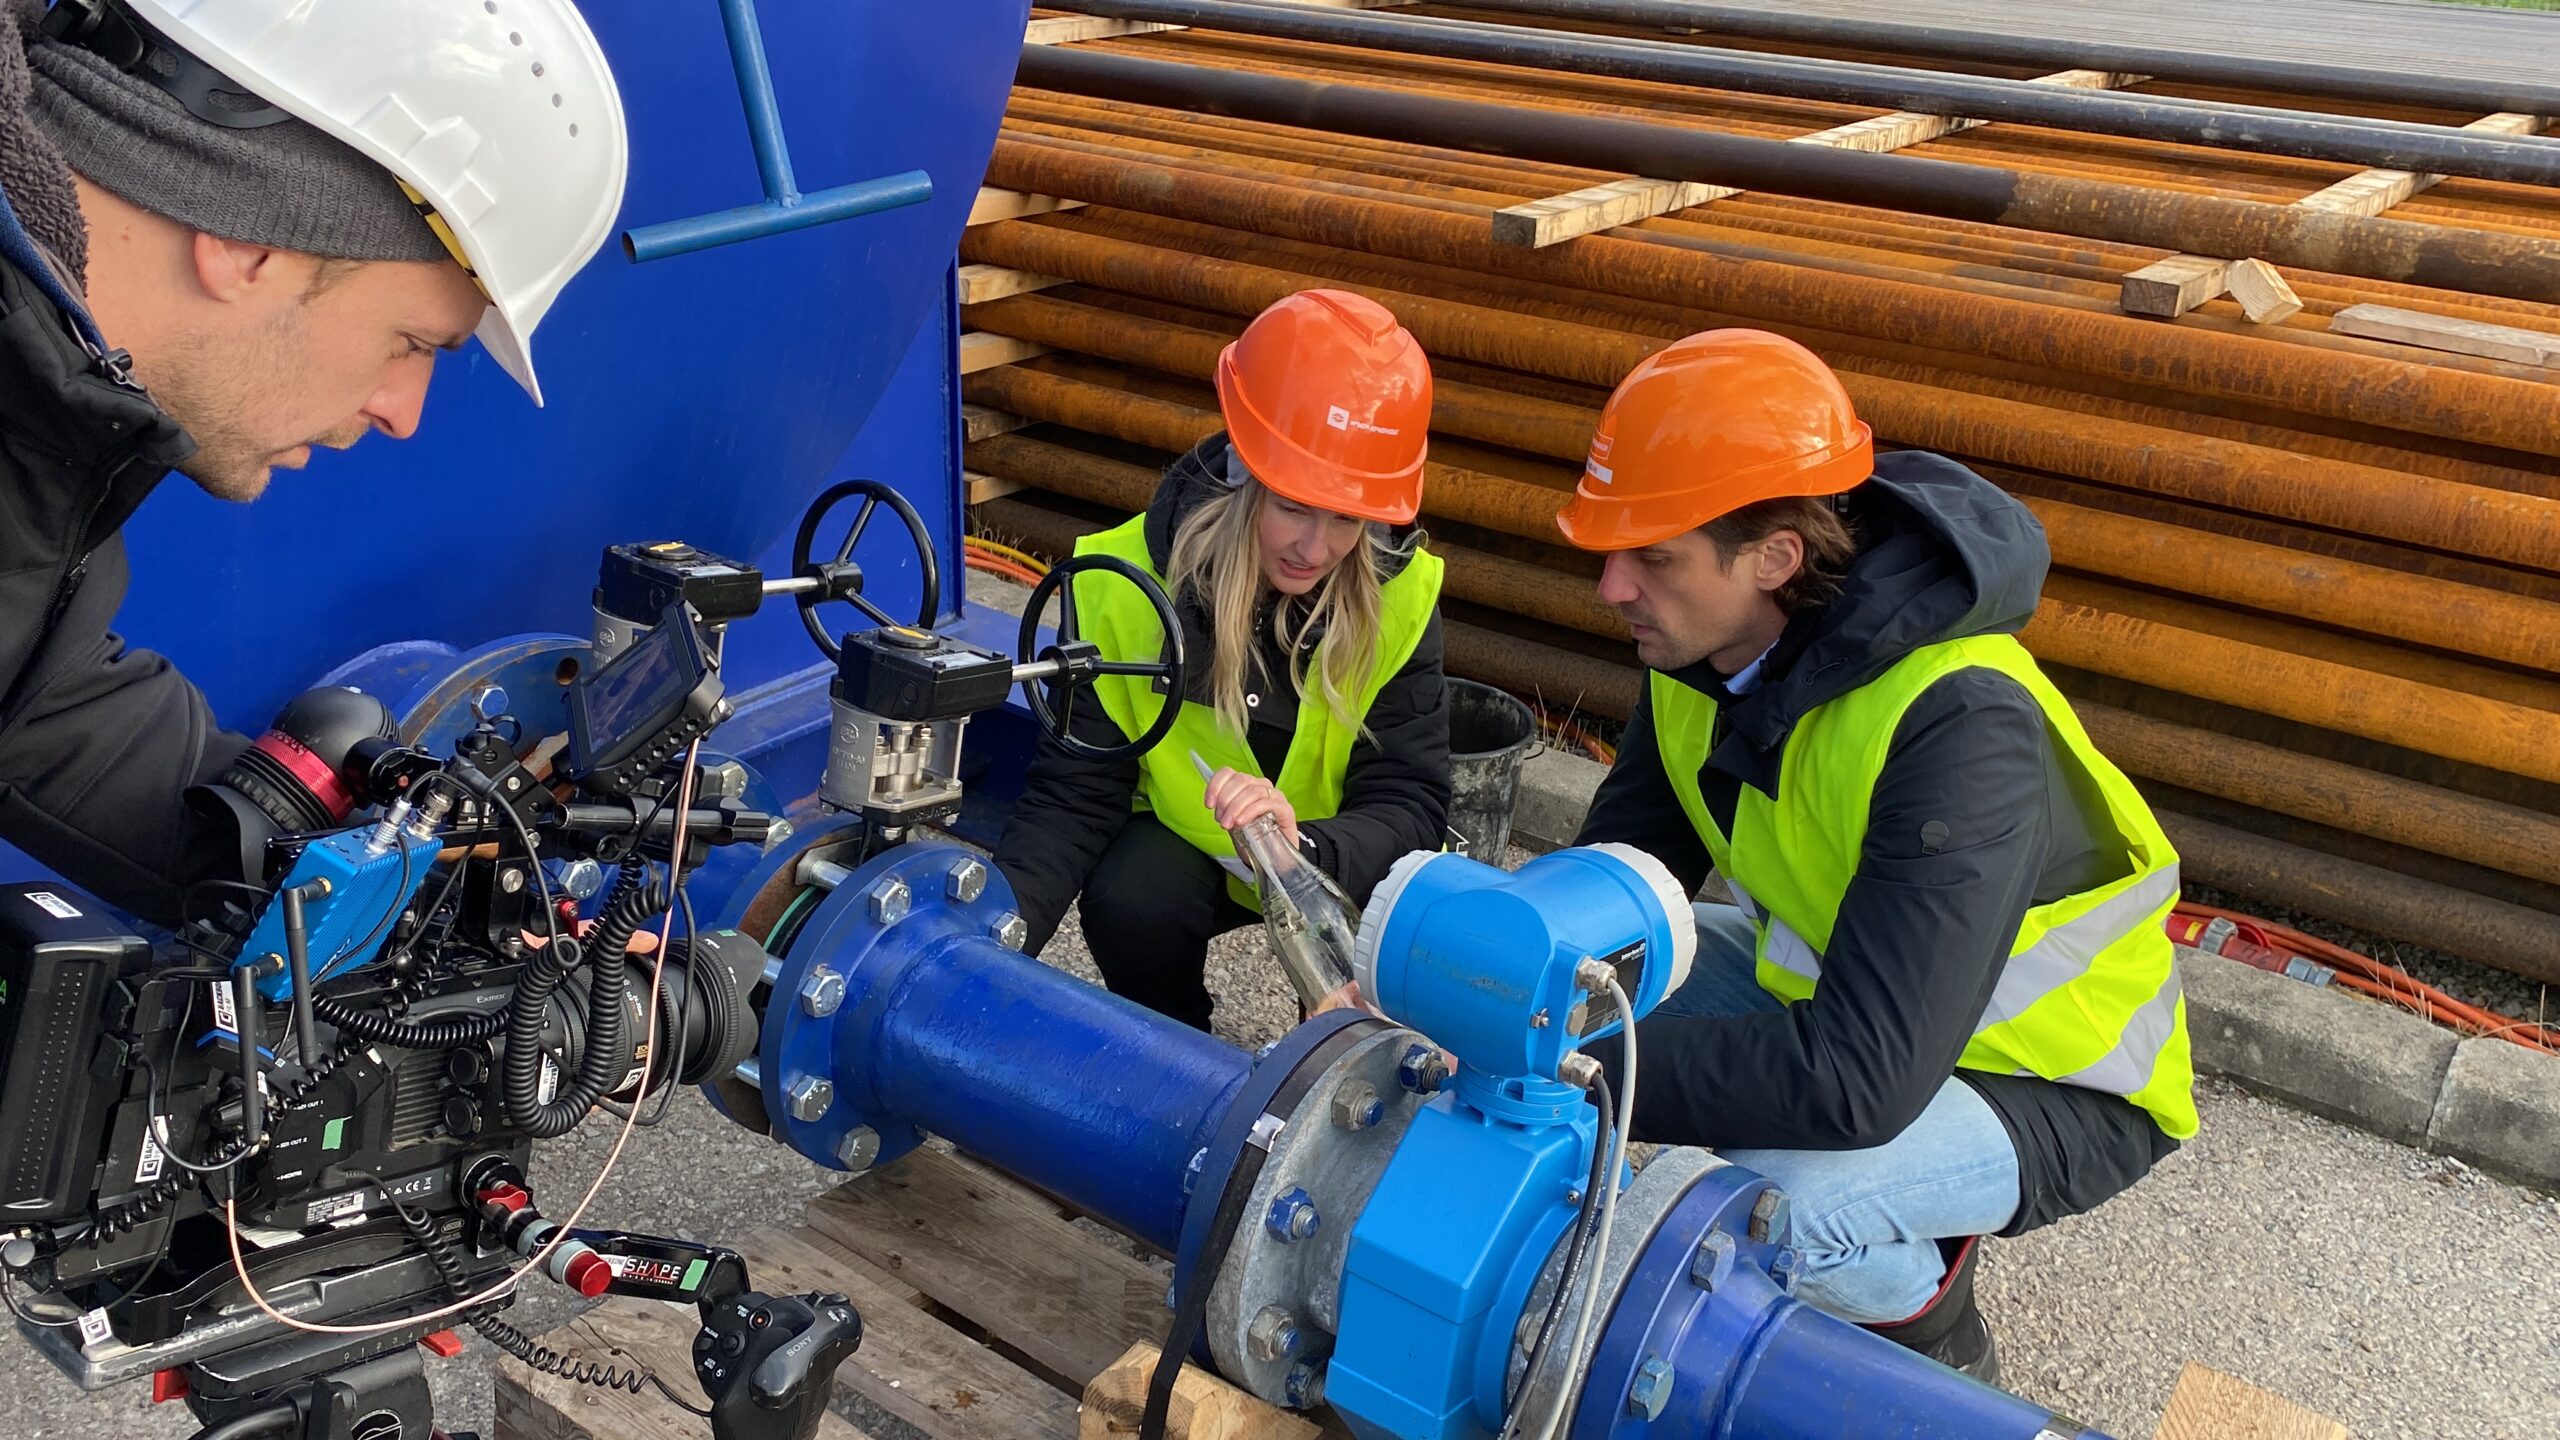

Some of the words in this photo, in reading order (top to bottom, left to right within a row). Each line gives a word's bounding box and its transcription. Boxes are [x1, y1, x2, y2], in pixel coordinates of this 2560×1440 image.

[476, 993, 507, 1004] Exmor
[405, 1180, 420, 1193] CE
[1573, 1249, 1583, 1271] WATER
[623, 1258, 682, 1280] SHAPE
[785, 1335, 813, 1358] SONY
[715, 1368, 724, 1378] 5
